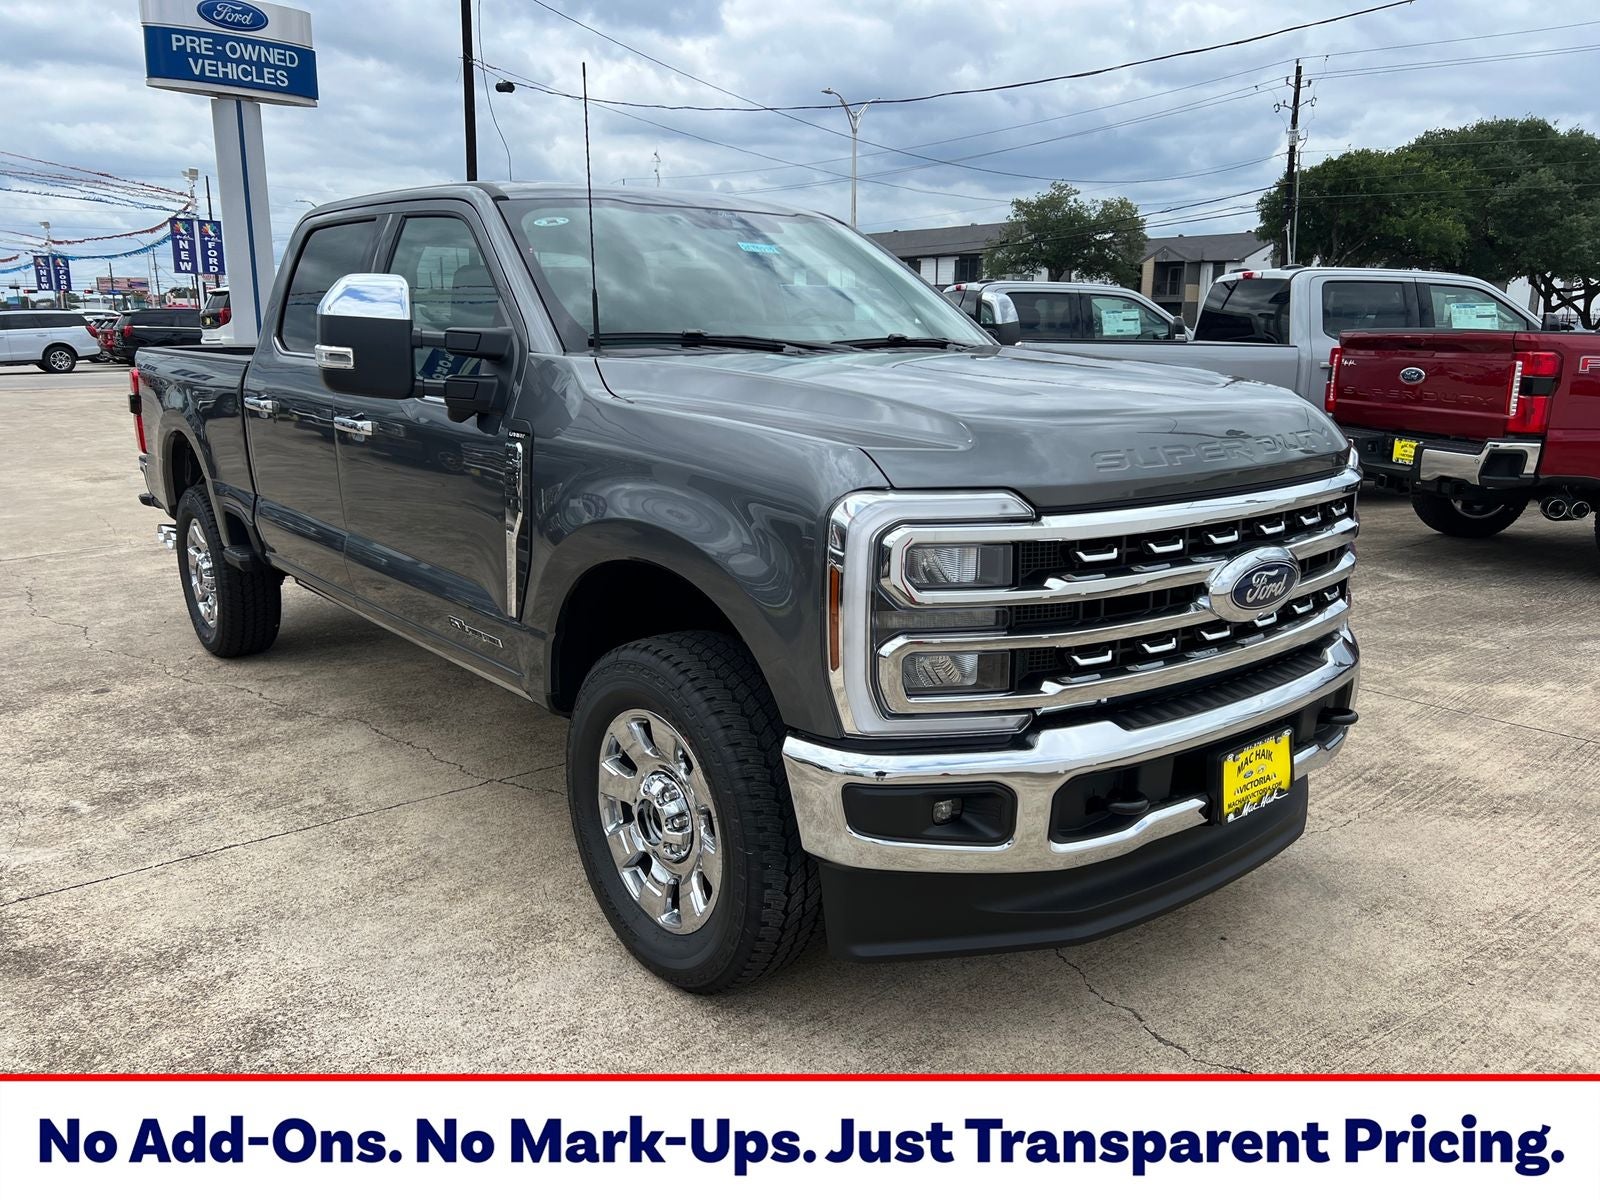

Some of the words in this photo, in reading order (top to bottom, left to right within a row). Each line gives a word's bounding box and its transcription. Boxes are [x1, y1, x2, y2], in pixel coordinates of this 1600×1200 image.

[213, 2, 253, 25] Ford
[188, 57, 289, 87] VEHICLES
[179, 240, 192, 271] NEW
[207, 241, 219, 273] FORD
[40, 269, 50, 290] NEW
[59, 269, 68, 290] FORD
[1343, 386, 1416, 400] SUPER
[1422, 392, 1494, 405] DUTY
[1091, 439, 1256, 472] SUPER
[1256, 429, 1328, 455] DUTY
[1246, 569, 1288, 603] Ford
[1237, 752, 1254, 777] MAC
[1255, 748, 1273, 762] HAIK
